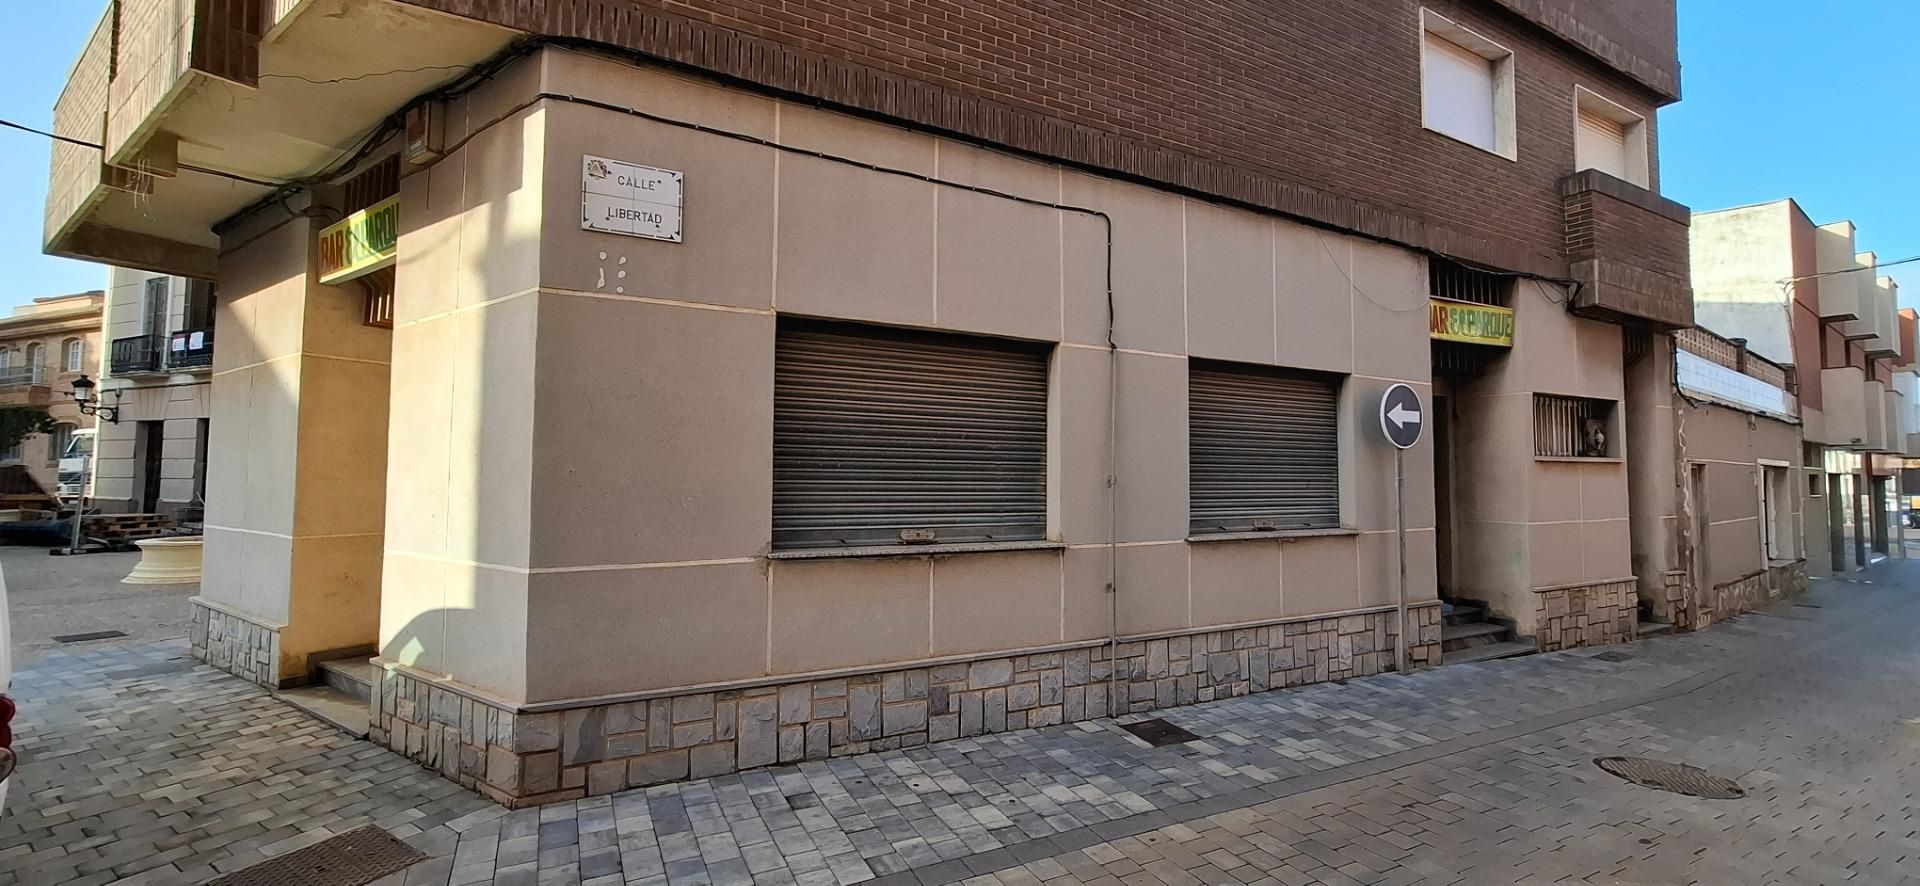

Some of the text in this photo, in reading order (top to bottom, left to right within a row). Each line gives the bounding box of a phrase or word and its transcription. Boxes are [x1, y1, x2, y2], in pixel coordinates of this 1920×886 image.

[617, 175, 656, 191] CALLE
[607, 206, 663, 224] LIBERTAD
[320, 229, 344, 273] BAR
[360, 202, 400, 253] PARQU
